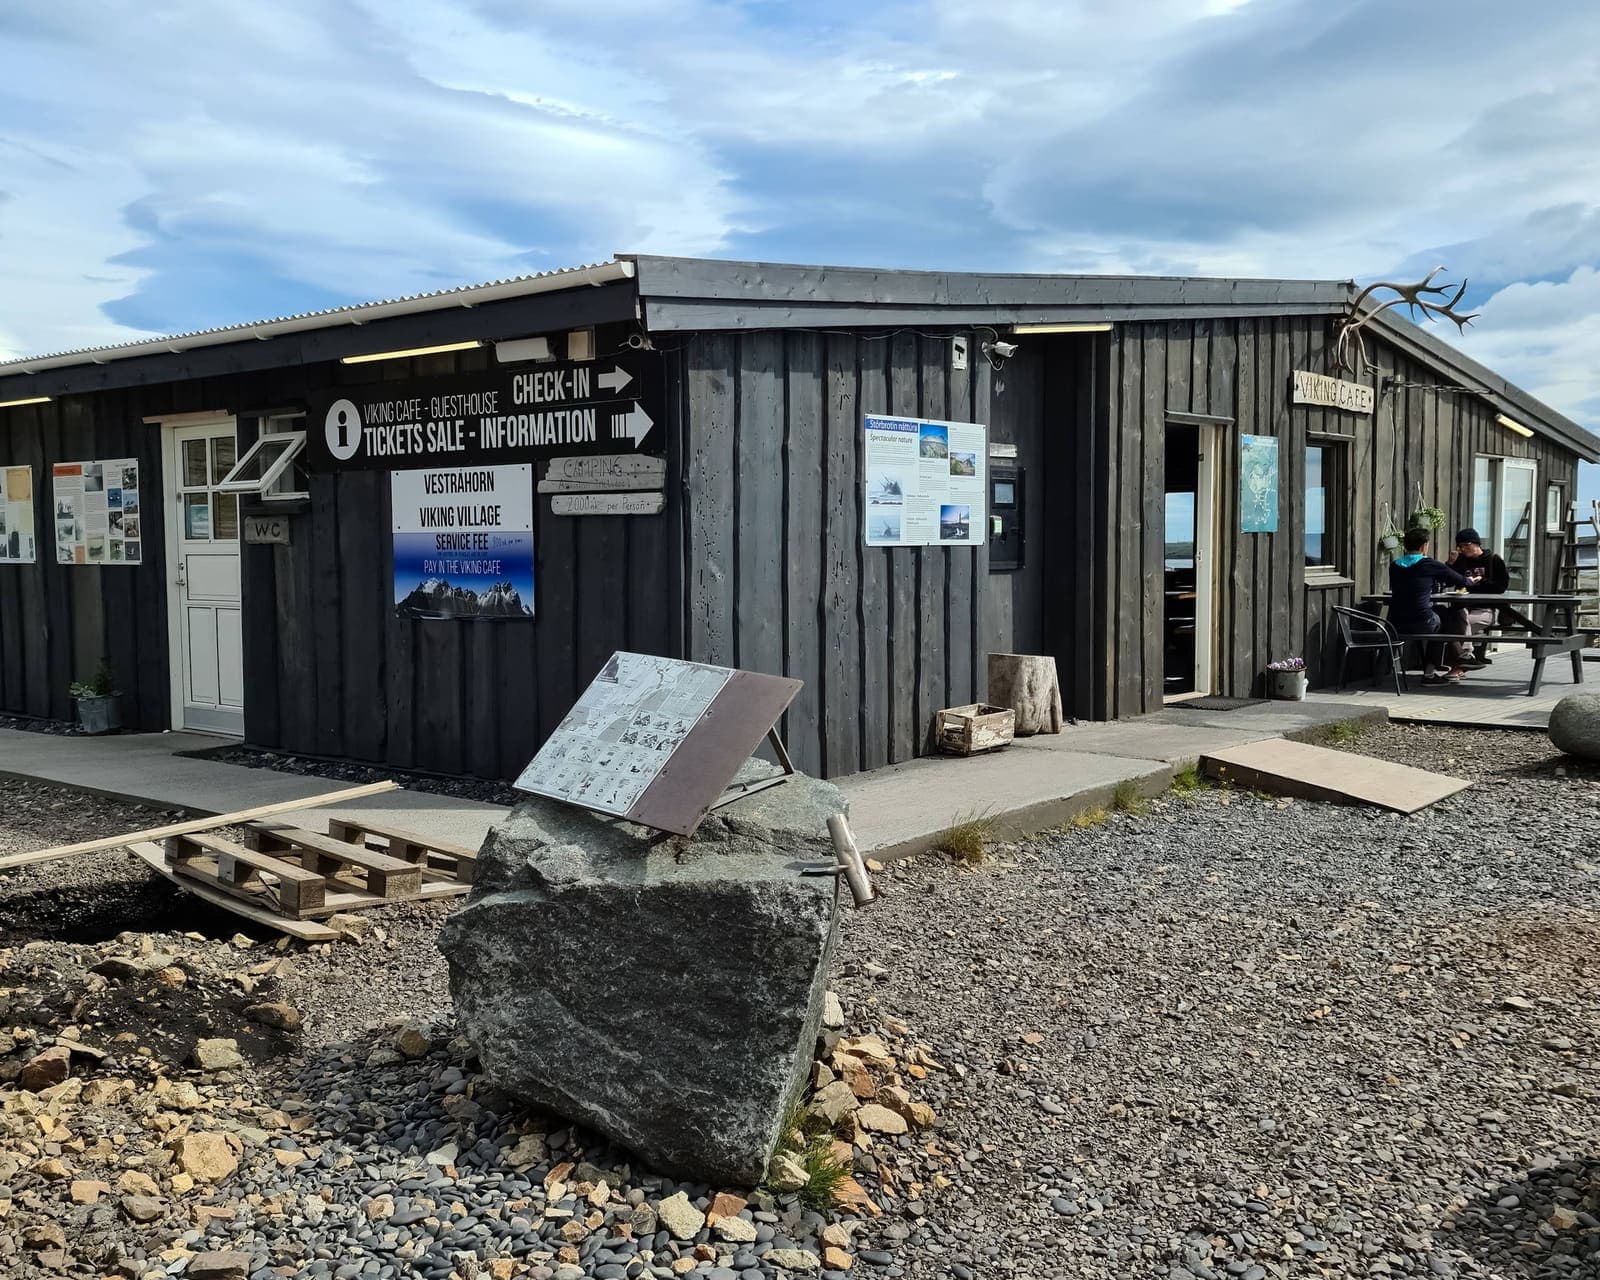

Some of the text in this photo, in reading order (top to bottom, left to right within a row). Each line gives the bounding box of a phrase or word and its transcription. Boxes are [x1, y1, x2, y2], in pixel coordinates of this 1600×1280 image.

[513, 367, 590, 405] CHECK-IN
[1300, 375, 1367, 408] VIKING CAFE
[363, 400, 395, 424] VIKING
[395, 398, 422, 421] CAFE
[430, 391, 499, 419] GUESTHOUSE
[363, 423, 423, 457] TICKETS
[426, 419, 465, 453] SALE
[480, 408, 597, 449] INFORMATION
[563, 456, 623, 478] CAMPING
[419, 505, 501, 528] VIKING VILLAGE
[255, 522, 281, 537] WC
[435, 533, 471, 551] SERVICE
[473, 533, 489, 550] FEE
[424, 559, 501, 575] PAY IN THE VIKING CAFE
